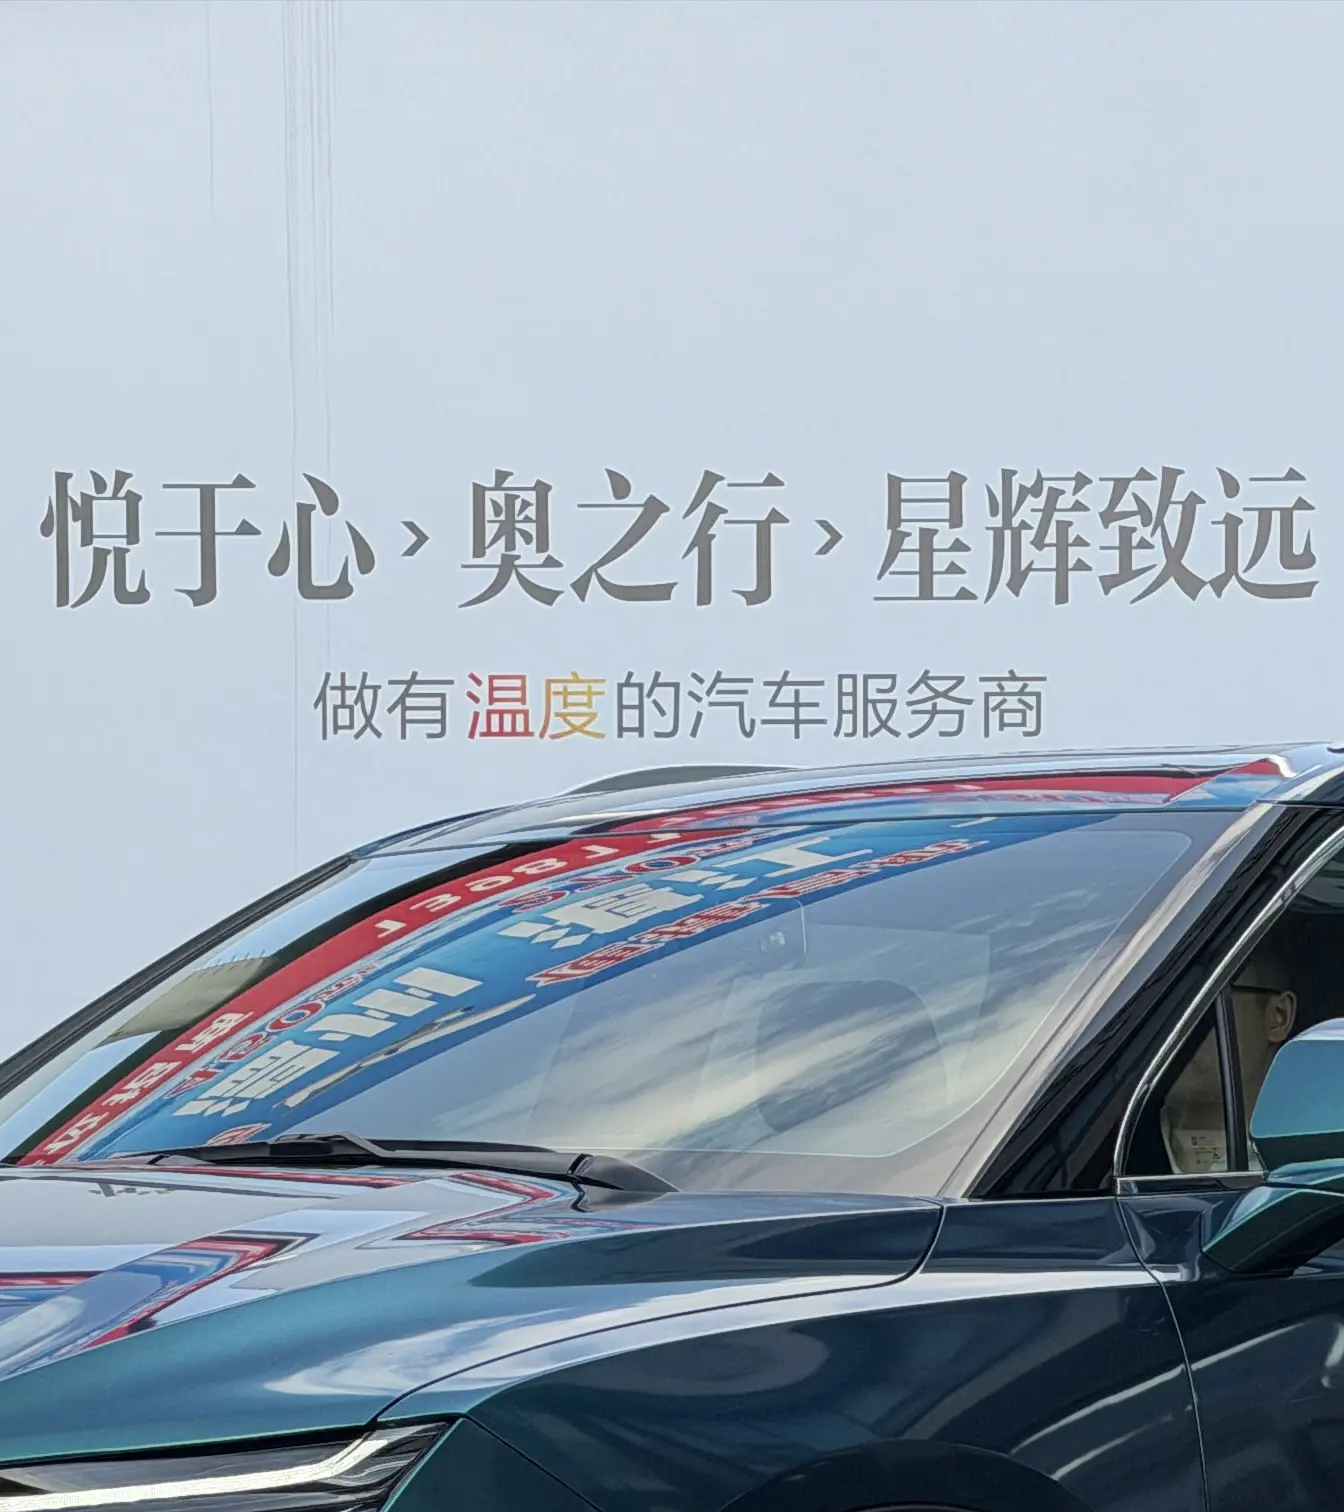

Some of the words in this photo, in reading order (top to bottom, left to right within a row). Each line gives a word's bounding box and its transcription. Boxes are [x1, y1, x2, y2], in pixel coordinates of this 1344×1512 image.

[313, 669, 1048, 742] 做有温度的汽车服务商
